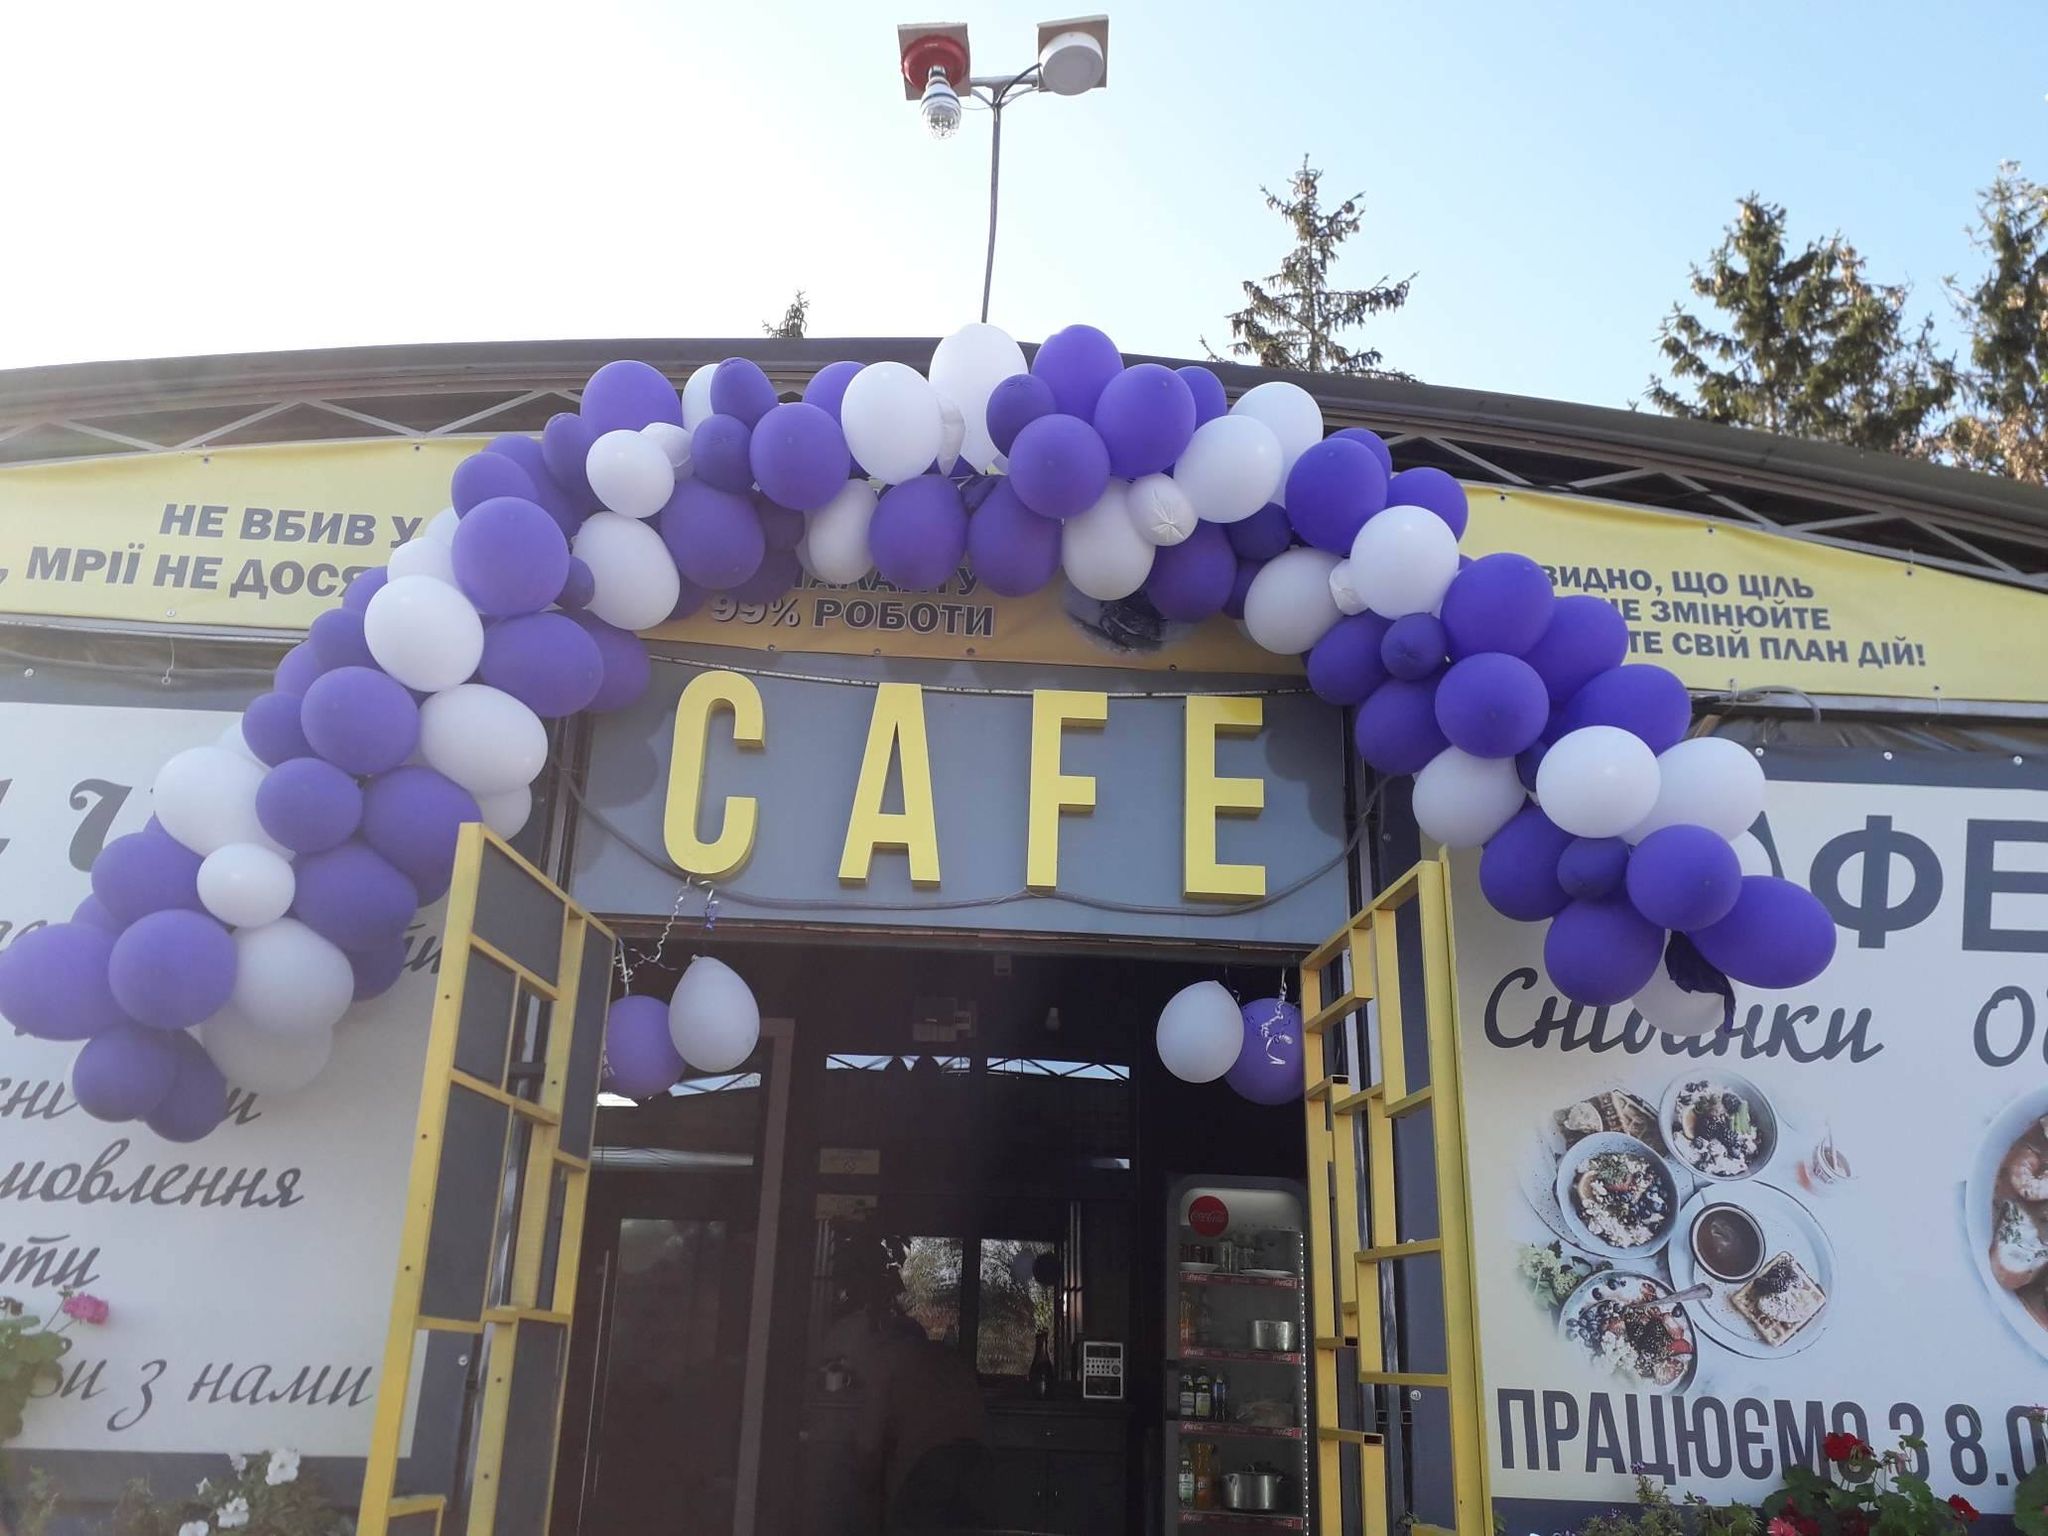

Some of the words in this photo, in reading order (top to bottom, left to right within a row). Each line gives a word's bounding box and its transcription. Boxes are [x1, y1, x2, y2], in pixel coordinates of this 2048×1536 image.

[158, 503, 229, 538] НЕ
[239, 507, 377, 546] ВБИВ
[25, 542, 146, 585] МРІЇ
[152, 554, 223, 590] НЕ
[1671, 571, 1729, 598] ЩО
[1738, 574, 1815, 600] ЦІЛЬ
[812, 598, 995, 638] РОБОТИ
[1650, 599, 1832, 631] ЗМІНЮЙТЕ
[1671, 628, 1751, 659] СВІЙ
[1759, 636, 1849, 663] ПЛАН
[1857, 635, 1927, 669] ДІЙ!
[663, 669, 1267, 899] CAFE
[1484, 967, 1884, 1064] Снінки
[187, 1361, 374, 1408] нами
[1496, 1387, 1876, 1486] ПРАЦЮЄМО
